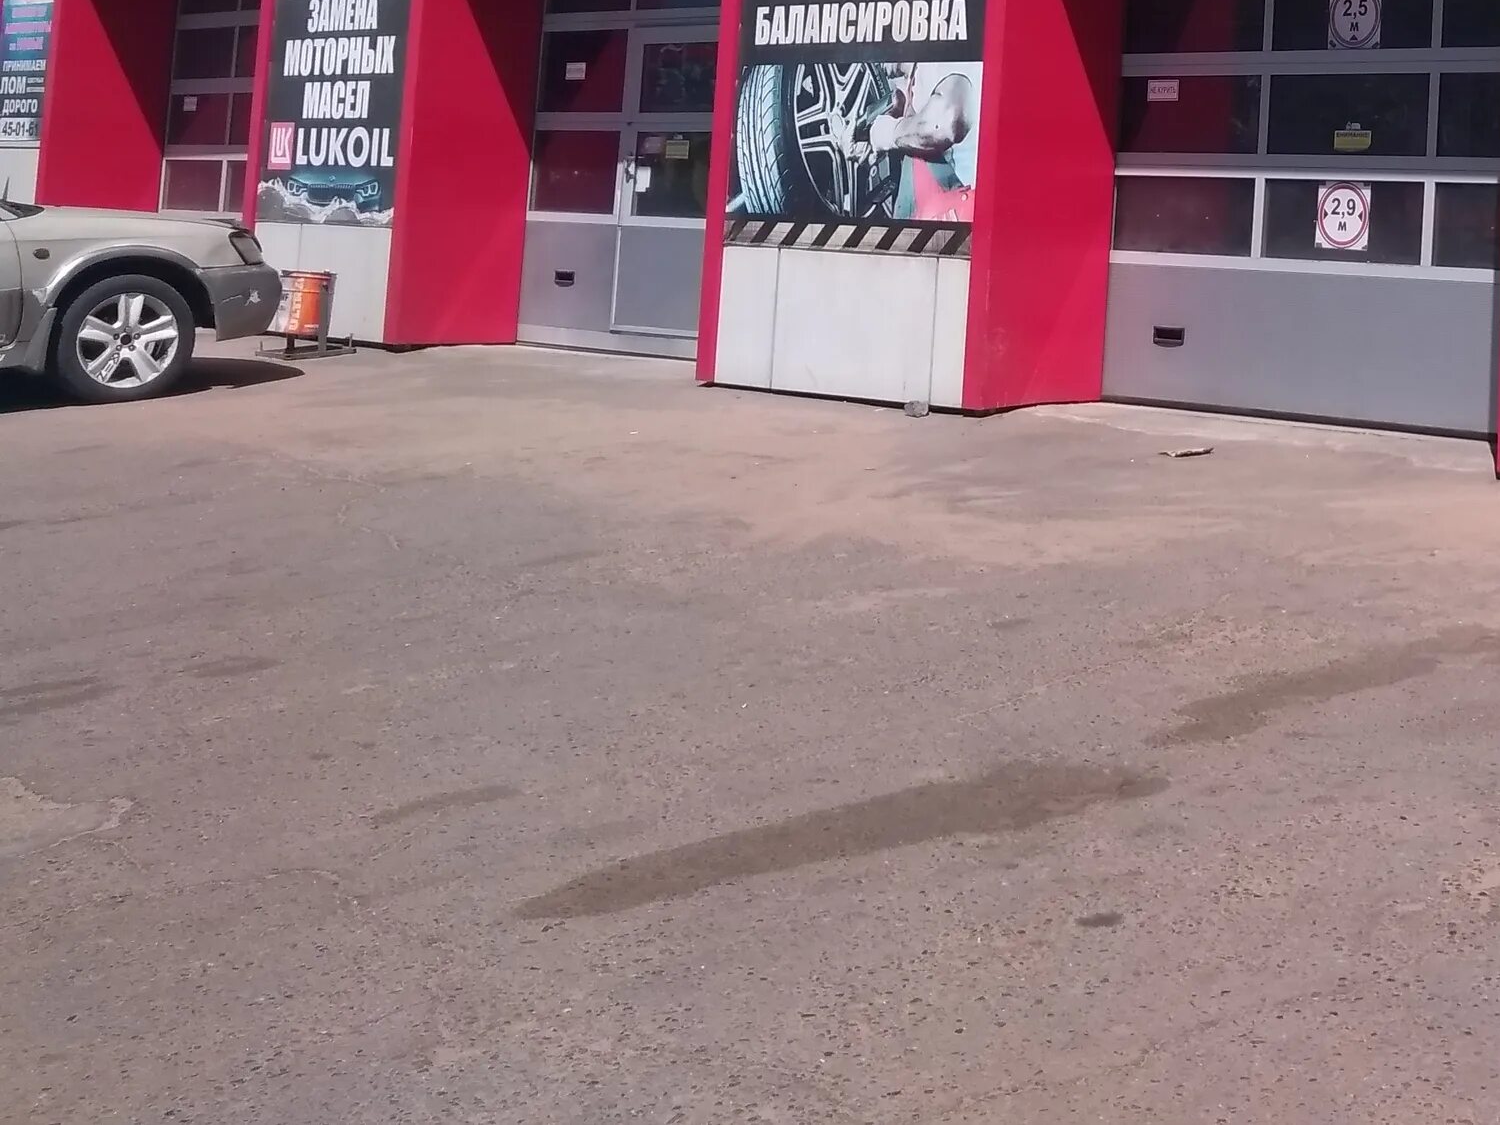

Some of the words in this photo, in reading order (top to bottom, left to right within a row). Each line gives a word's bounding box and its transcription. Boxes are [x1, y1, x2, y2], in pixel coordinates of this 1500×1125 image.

[754, 0, 967, 46] БАЛАНСИРОВКА
[1343, 0, 1368, 19] 2,5
[283, 35, 396, 77] МОТОРНЫХ
[0, 76, 26, 94] ЛОМ
[302, 80, 371, 120] МАСЕЛ
[2, 99, 38, 116] ДОРОГО
[295, 126, 393, 168] LUKOIL
[1331, 198, 1356, 219] 2,9
